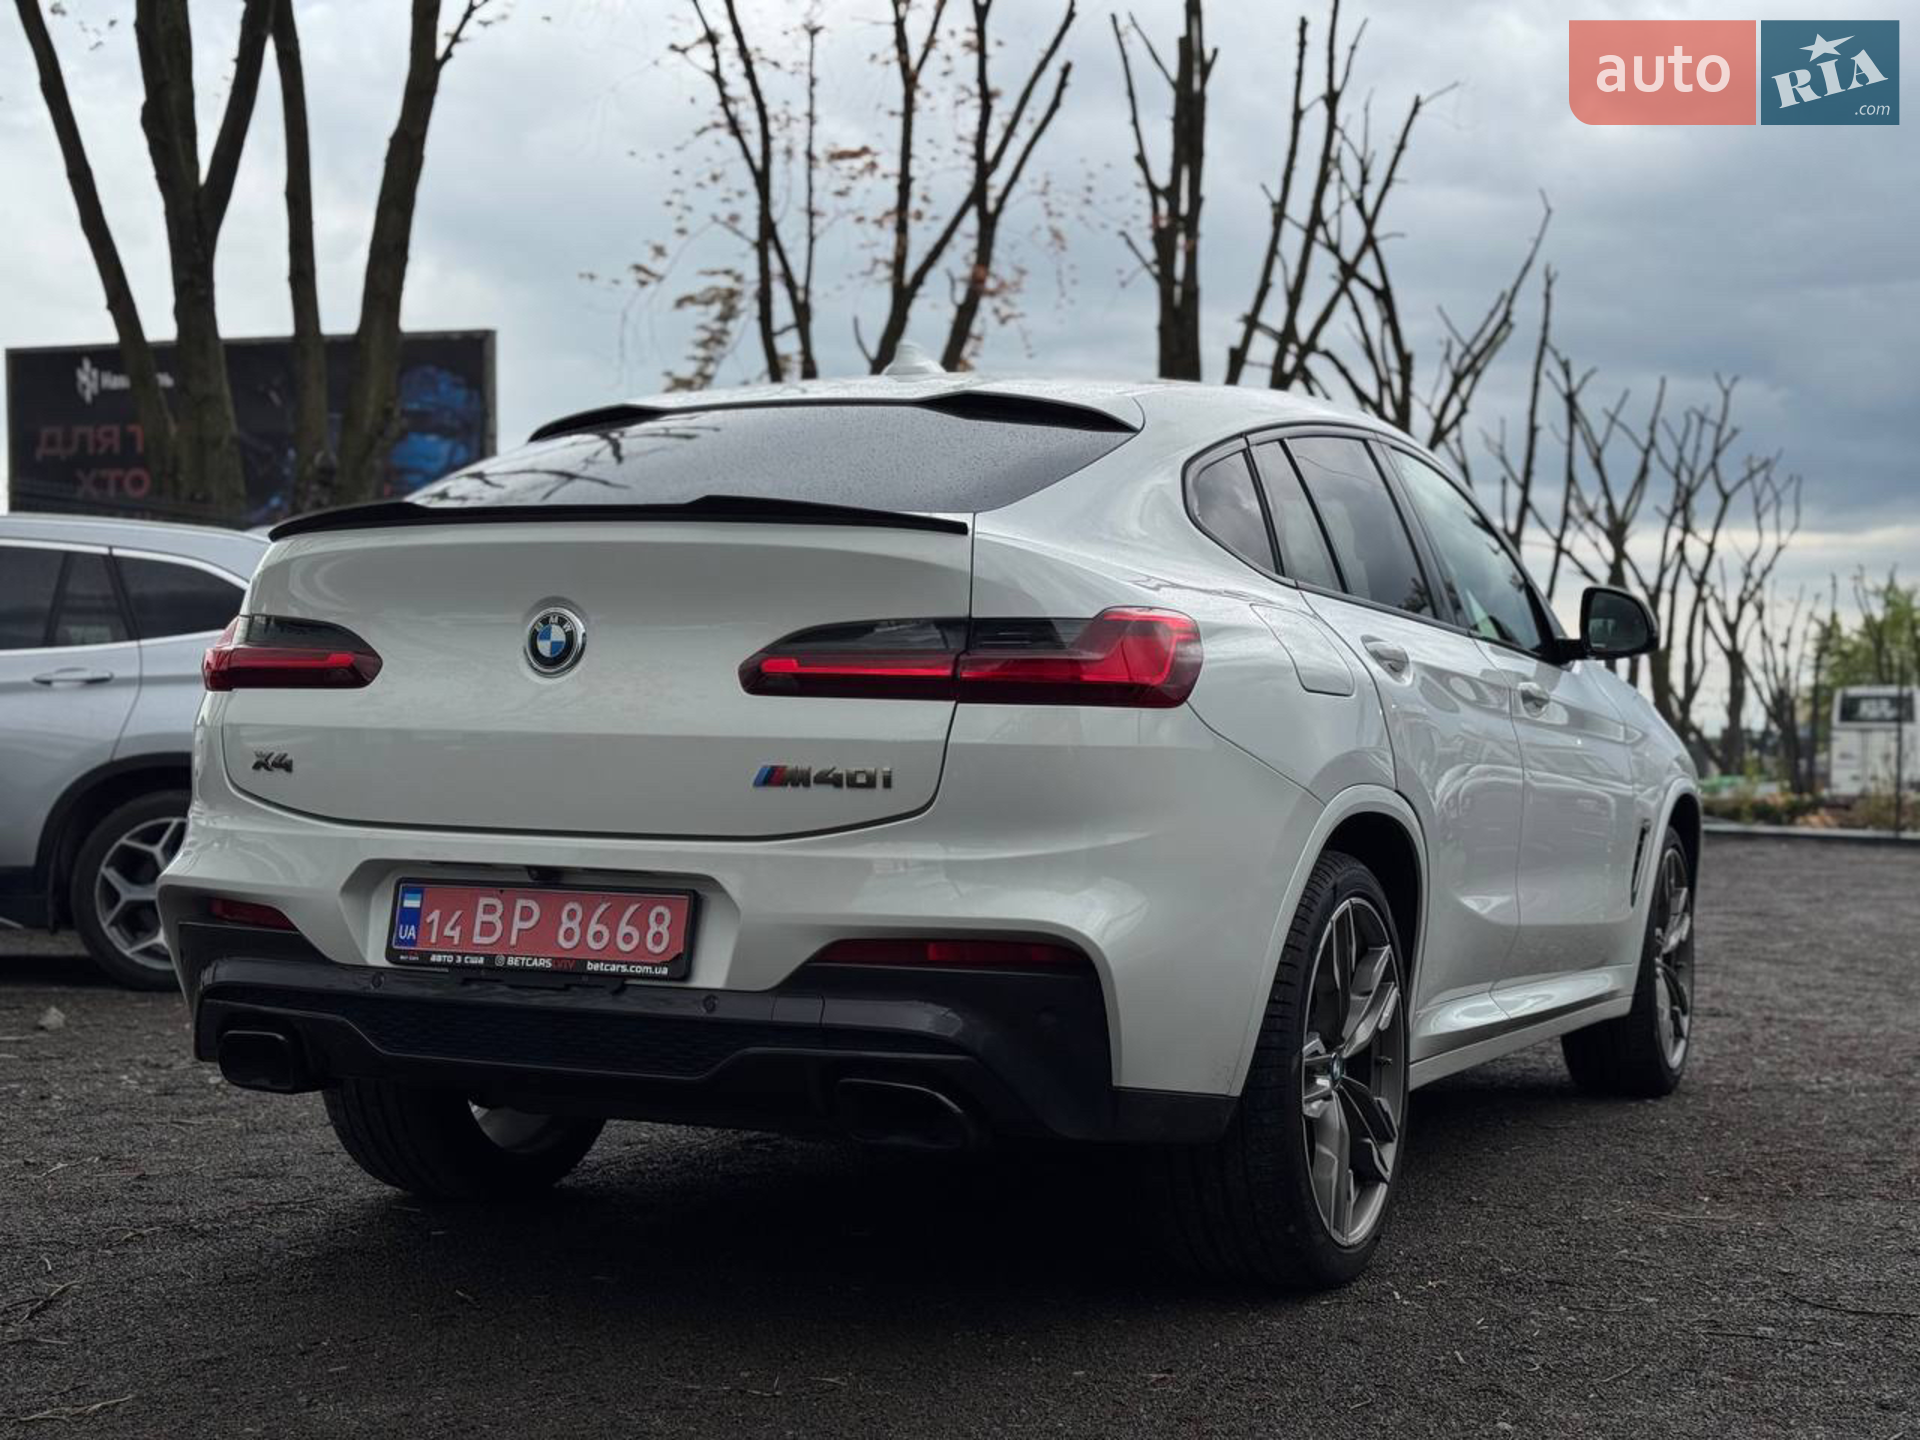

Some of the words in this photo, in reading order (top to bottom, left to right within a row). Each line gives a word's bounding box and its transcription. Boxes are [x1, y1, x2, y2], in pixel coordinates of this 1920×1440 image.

[36, 425, 121, 462] ДЛЯ
[76, 467, 151, 499] ХТО
[251, 751, 293, 773] X4
[399, 925, 417, 941] UA
[424, 908, 463, 946] 14
[472, 896, 541, 947] BP
[556, 901, 673, 955] 8668
[586, 960, 669, 976] betcars.com.ua
